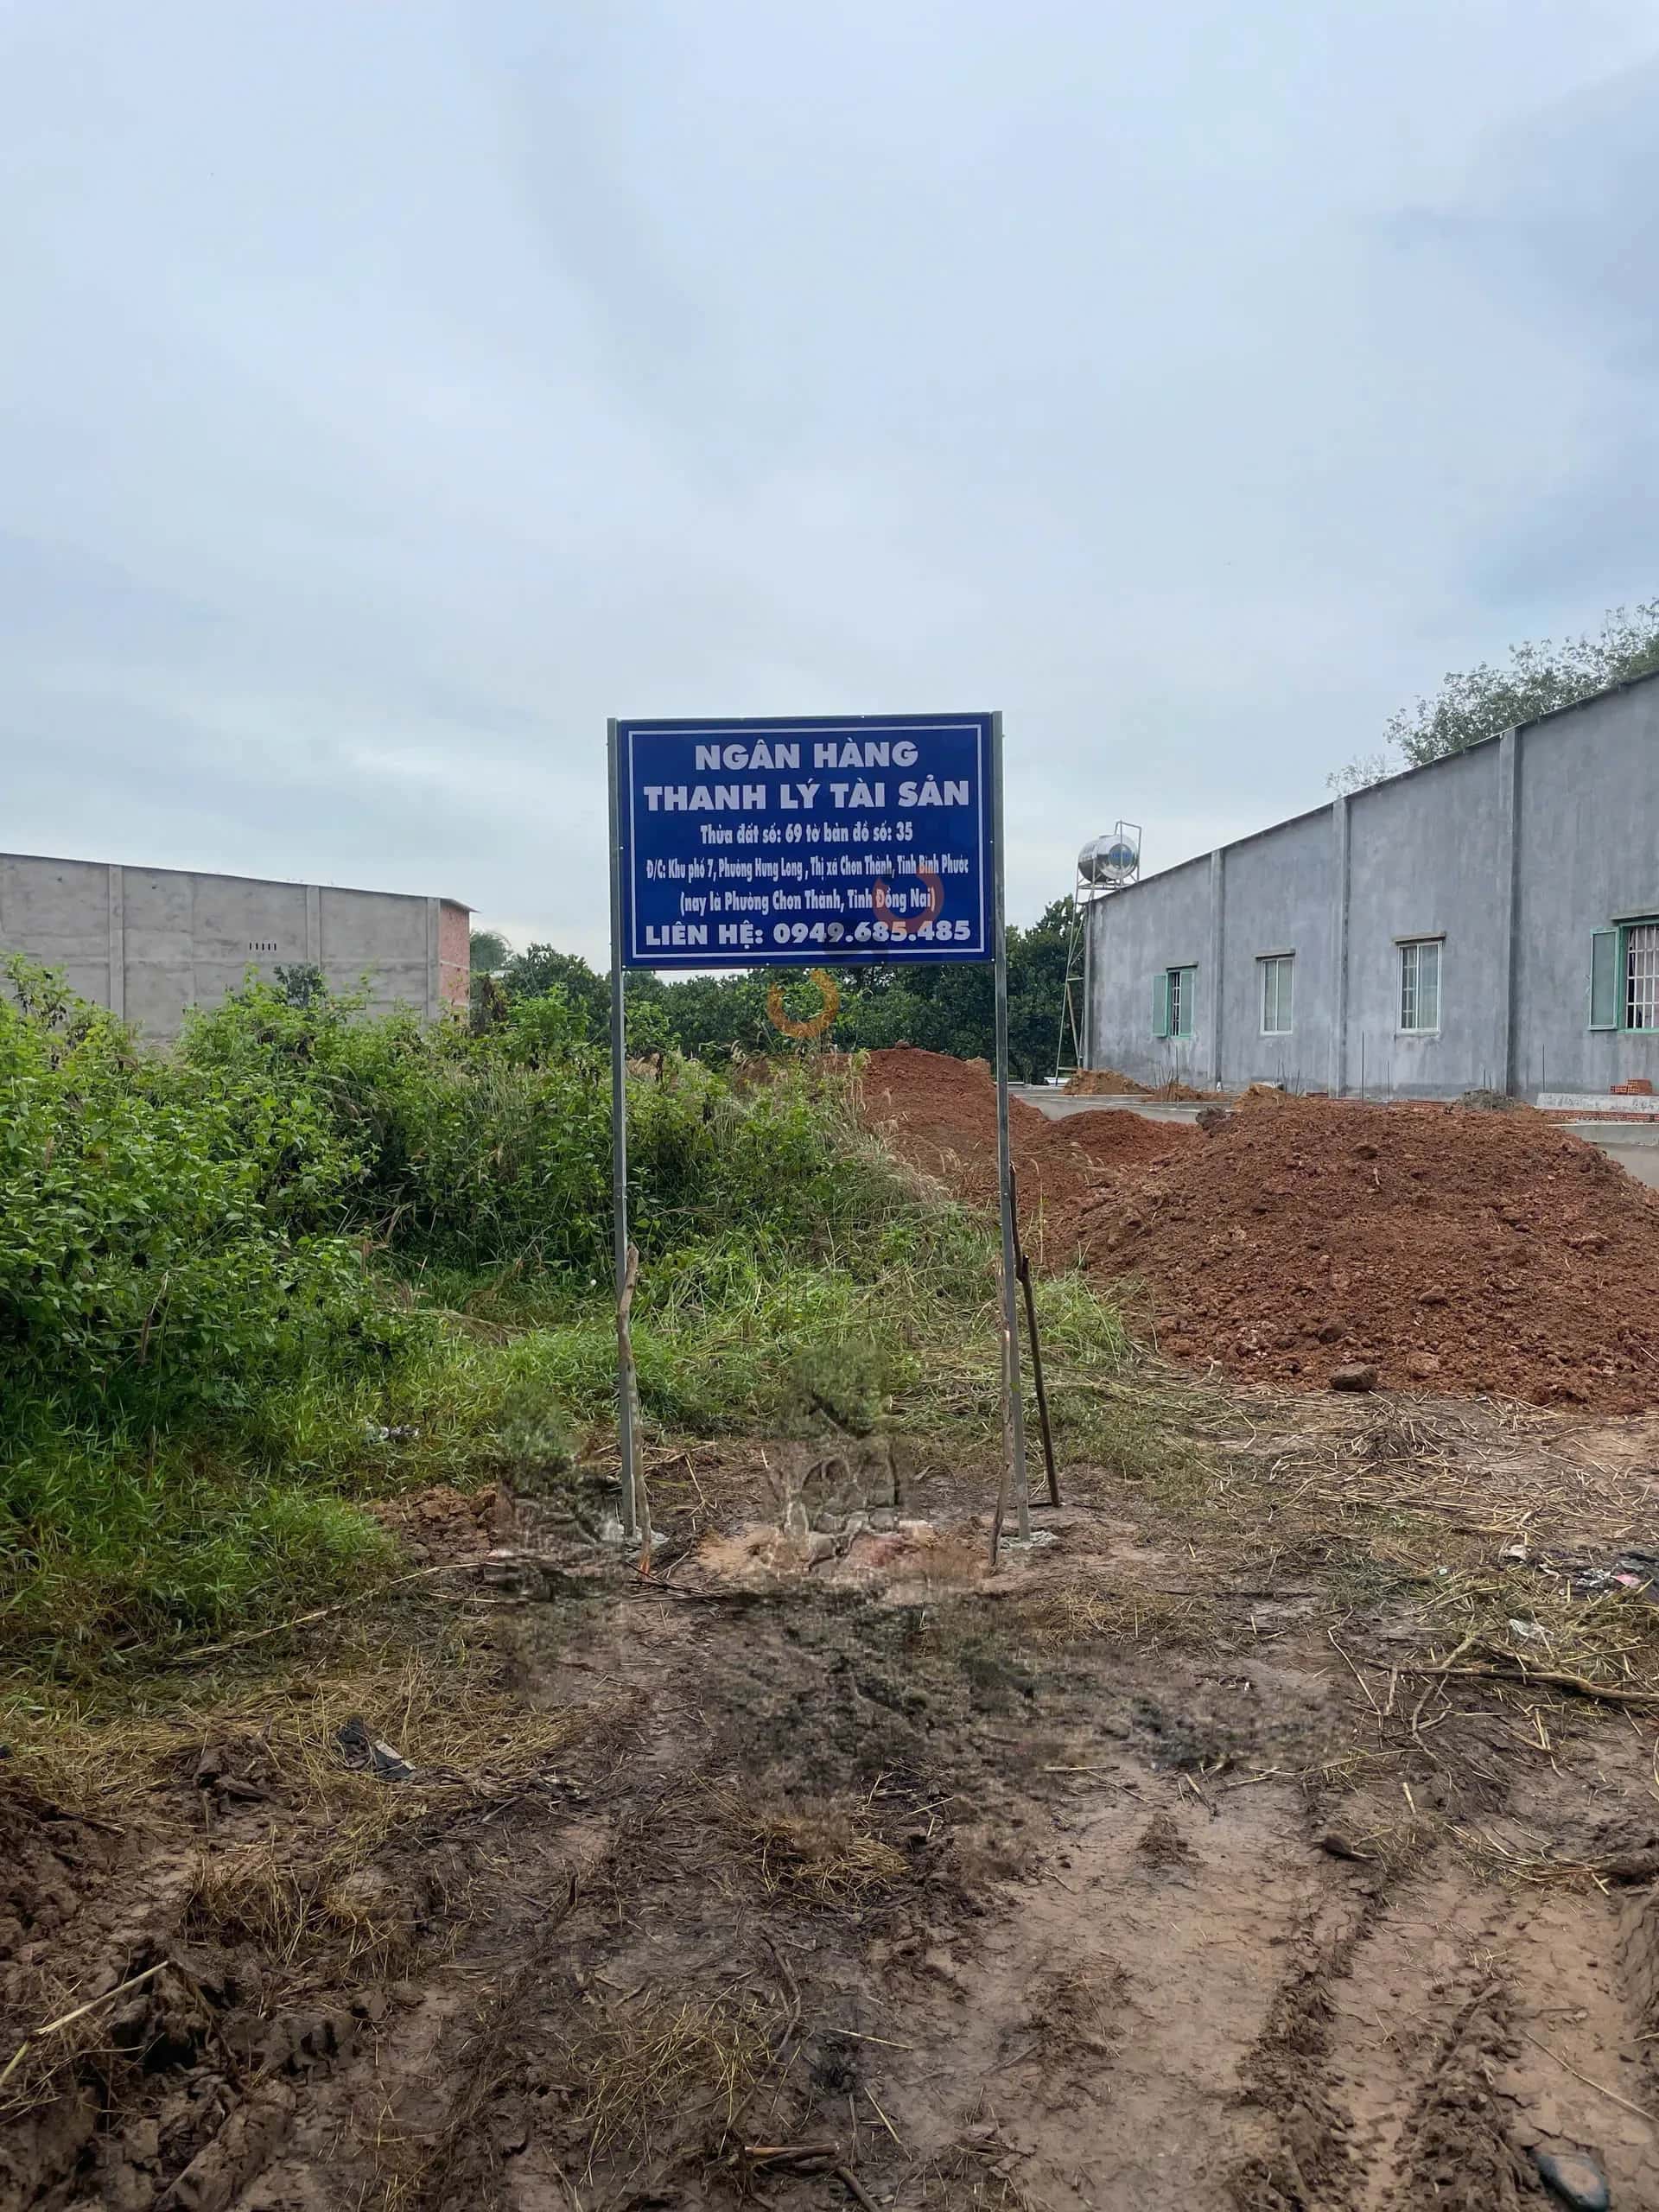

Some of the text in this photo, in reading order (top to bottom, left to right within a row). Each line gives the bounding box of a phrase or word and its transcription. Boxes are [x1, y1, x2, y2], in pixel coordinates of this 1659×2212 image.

[695, 736, 919, 771] NGÂN HÀNG
[643, 773, 970, 811] THANH LÝ TÀI SẢN
[736, 822, 759, 845] đất
[762, 820, 781, 844] số:
[785, 823, 803, 844] 69
[805, 822, 822, 844] tờ
[852, 819, 869, 842] đồ
[873, 818, 893, 842] số:
[895, 820, 914, 842] 35
[646, 858, 667, 880] Đ/C:
[668, 857, 687, 880] Khu
[688, 856, 706, 884] phố
[707, 857, 717, 882] 7,
[780, 856, 803, 882] Long
[810, 855, 825, 881] Thị
[864, 854, 895, 879] Thành,
[918, 852, 940, 876] Bình
[941, 852, 969, 875] Phước
[679, 891, 708, 918] (nay
[709, 890, 722, 912] là
[804, 887, 845, 913] Thành,
[875, 885, 908, 914] Đồng
[909, 886, 937, 912] Nai)
[645, 919, 971, 950] LIÊN HỆ: 0949.685.485
